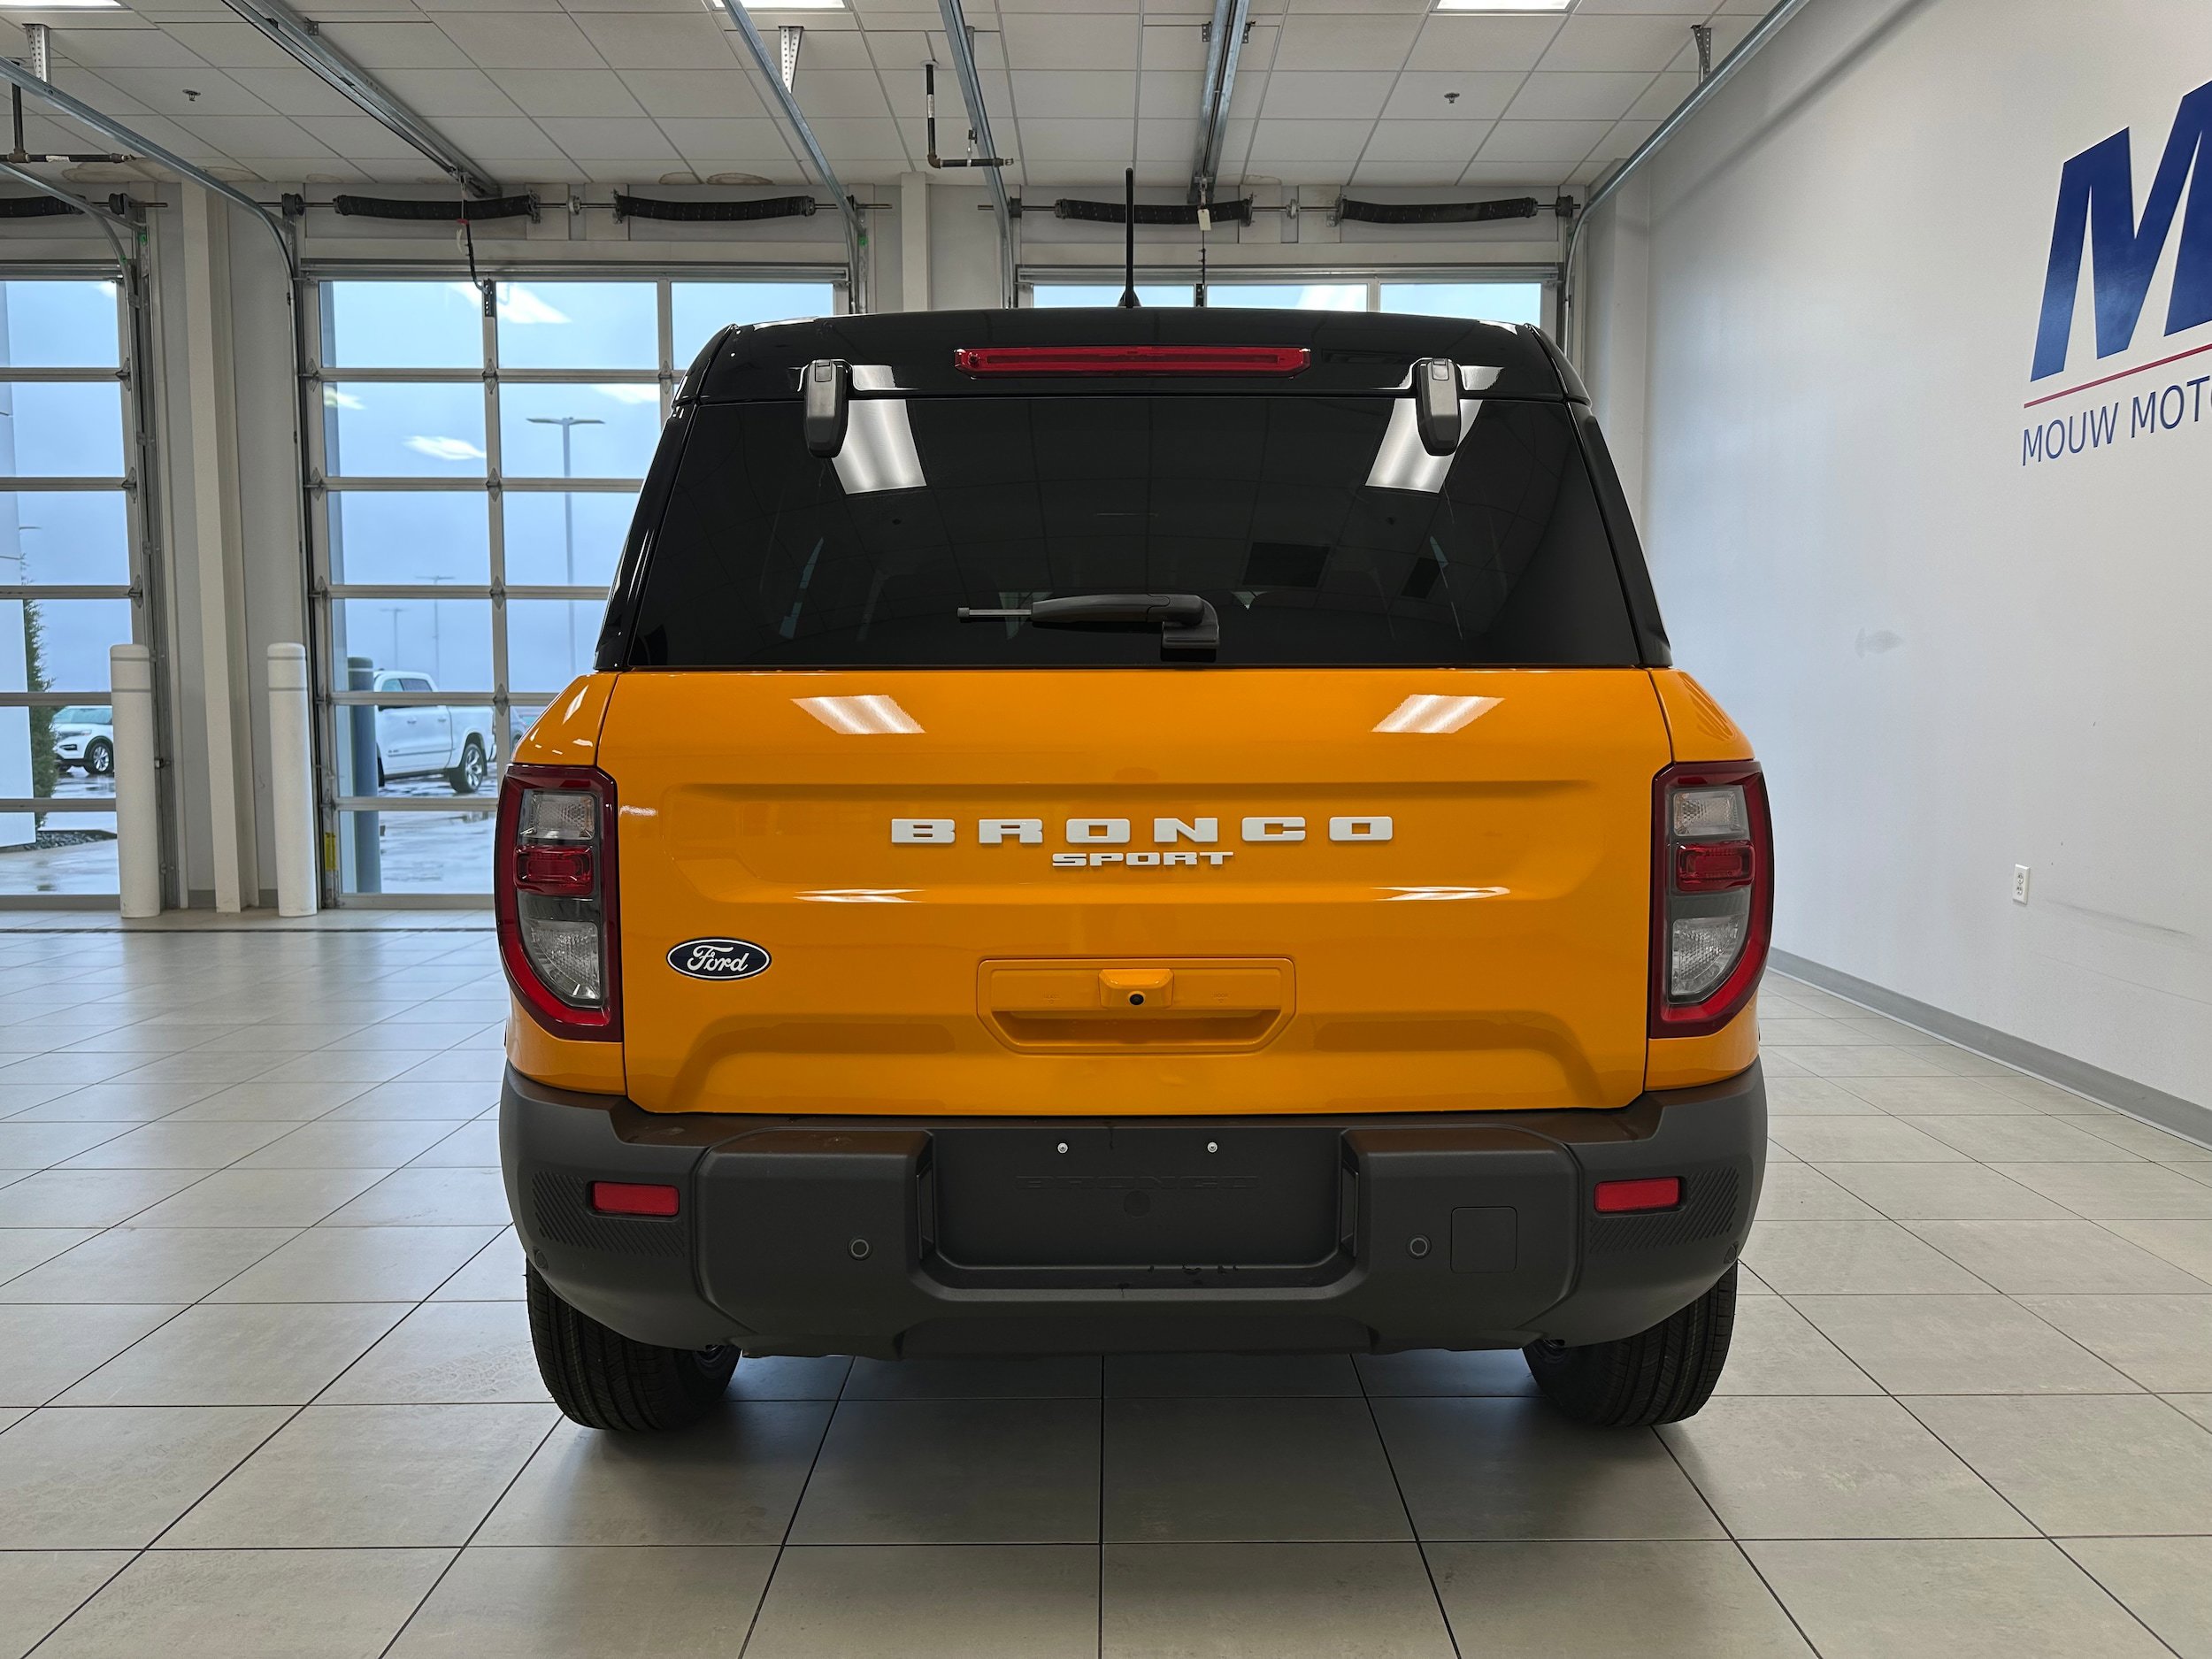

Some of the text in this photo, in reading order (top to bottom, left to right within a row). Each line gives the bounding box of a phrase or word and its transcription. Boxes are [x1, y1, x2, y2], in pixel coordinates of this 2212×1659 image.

[2023, 375, 2212, 466] MOUW MOT
[891, 816, 1394, 844] BRONCO
[1052, 851, 1233, 867] SPORT
[687, 945, 749, 972] Ford
